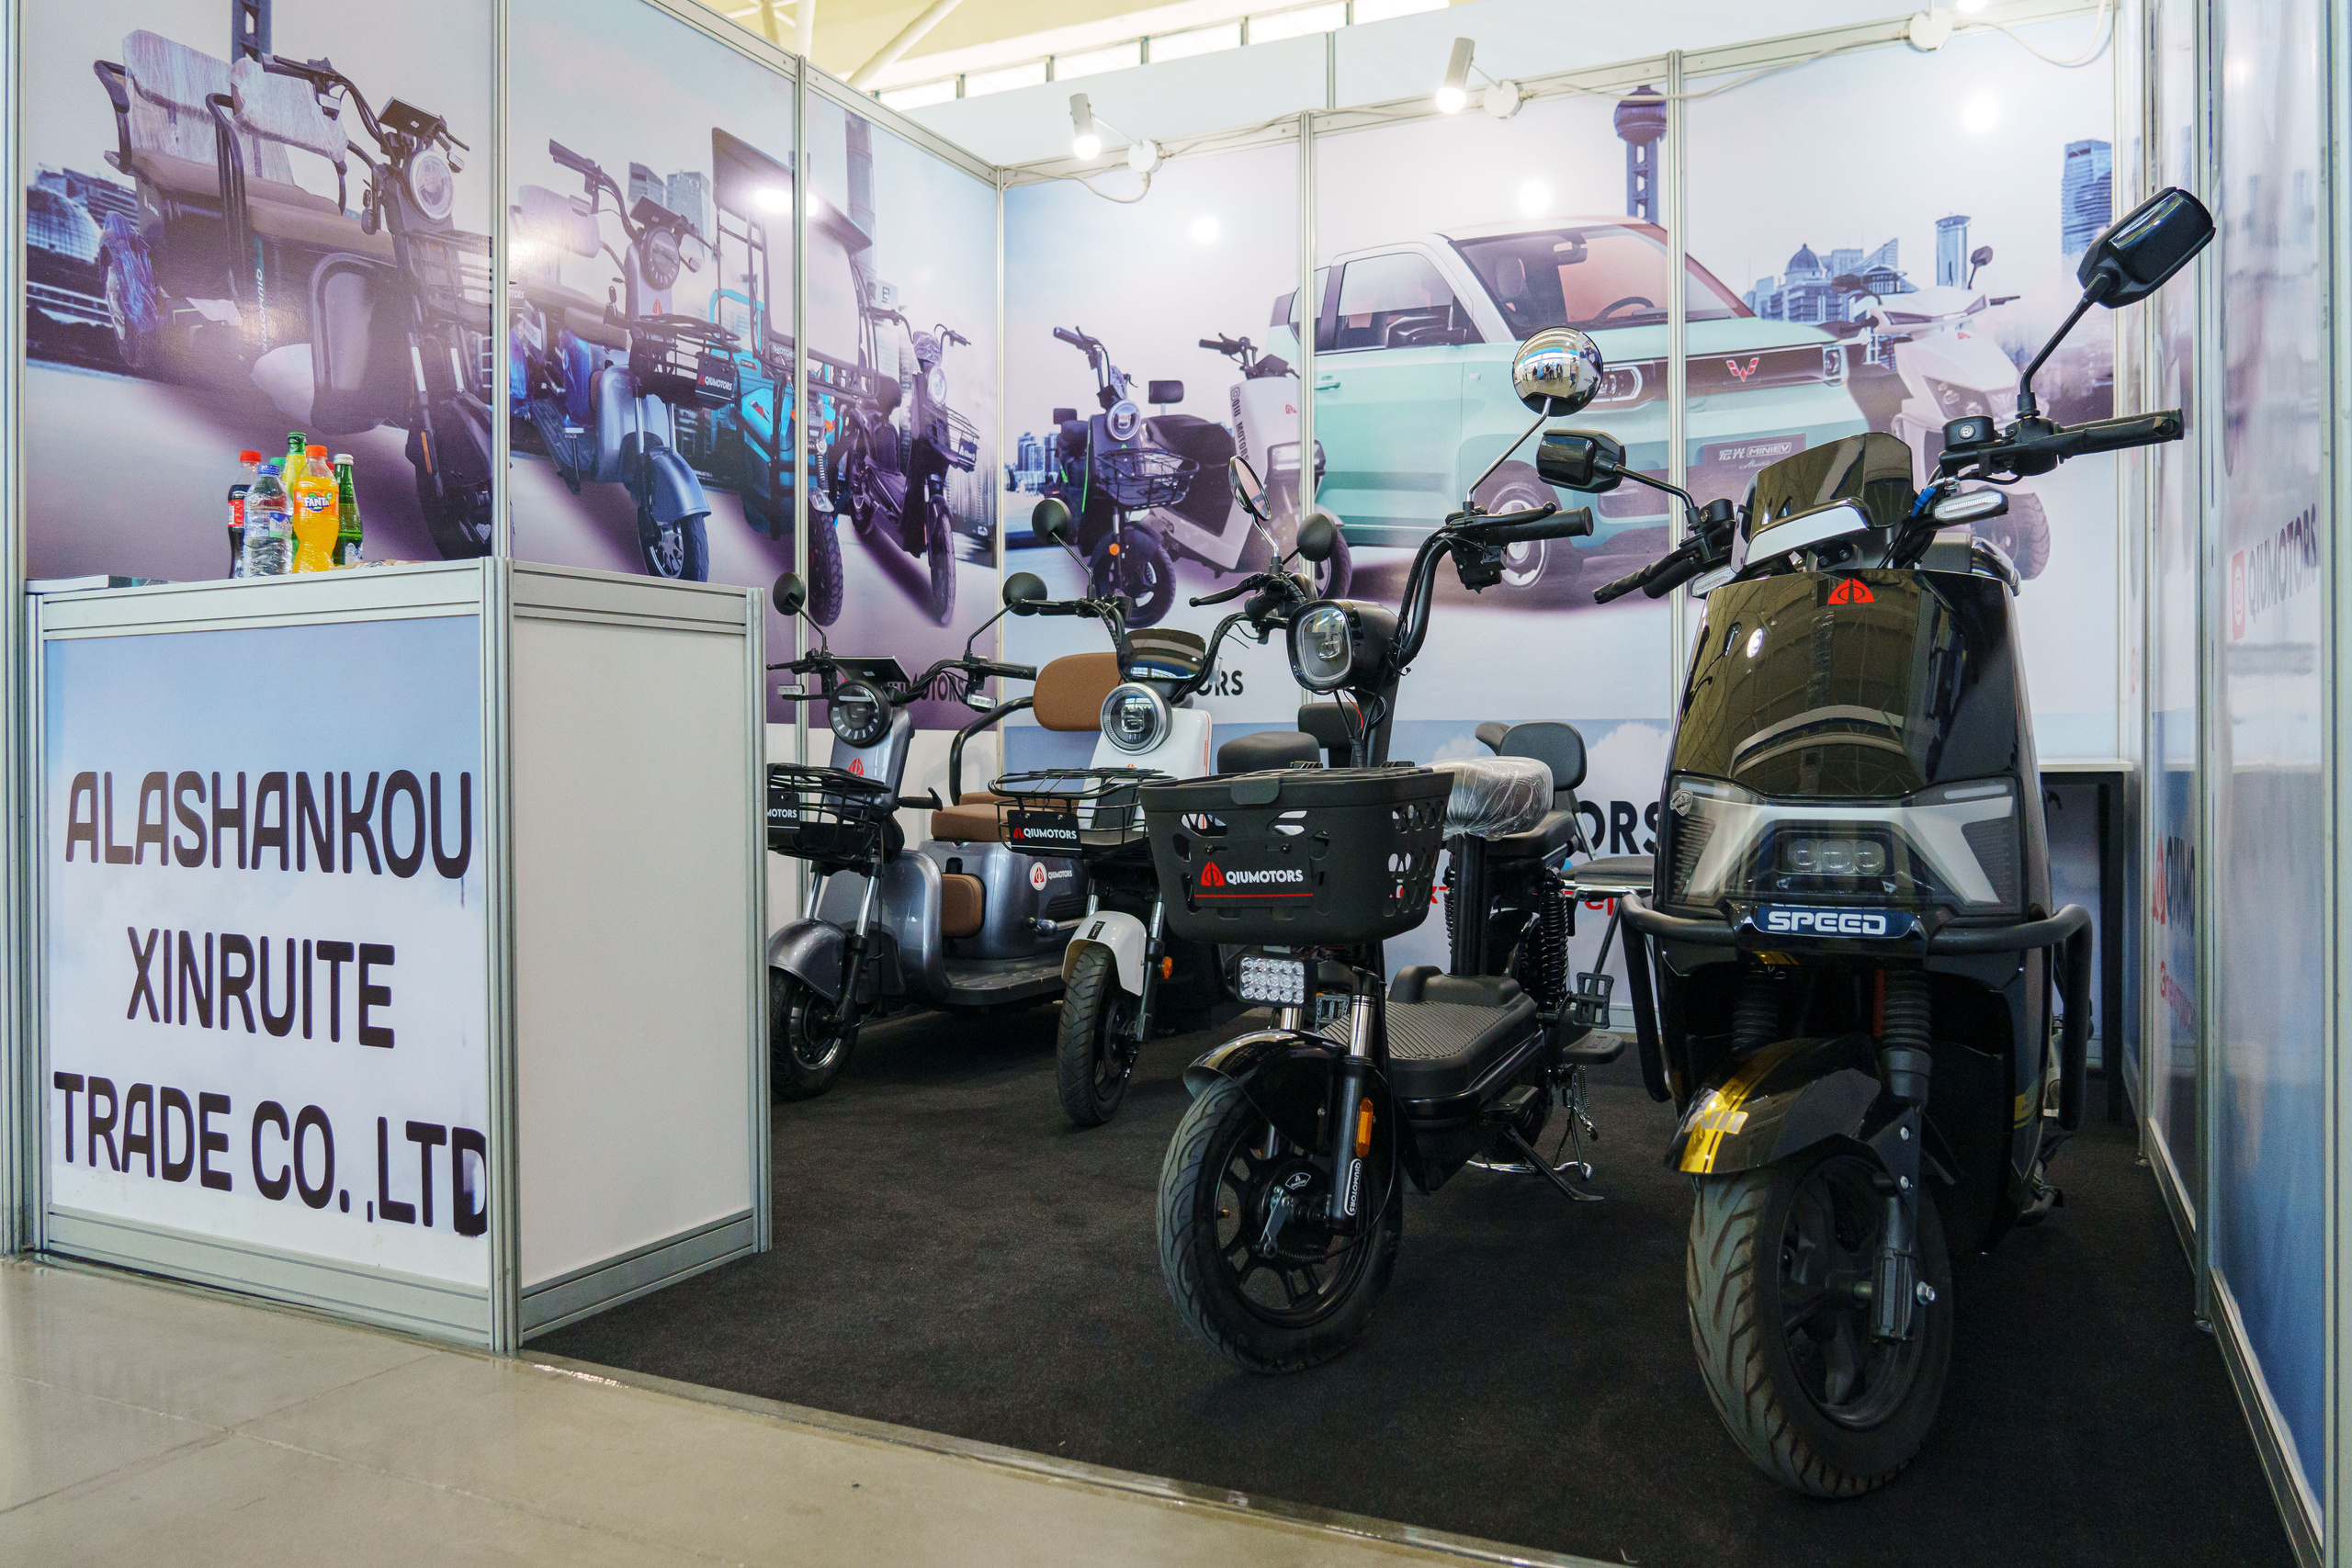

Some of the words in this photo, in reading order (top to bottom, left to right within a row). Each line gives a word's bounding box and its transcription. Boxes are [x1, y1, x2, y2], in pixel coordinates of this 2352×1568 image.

[705, 376, 733, 391] QIUMOTORS
[1748, 444, 1790, 457] MINIEV
[303, 496, 330, 507] FANTA
[2248, 503, 2316, 625] QIUMOTORS
[66, 770, 472, 879] ALASHANKOU
[1023, 828, 1077, 840] QIUMOTORS
[1047, 870, 1073, 880] QIUMOTORS
[1226, 869, 1304, 885] QIUMOTORS
[1768, 911, 1886, 935] SPEED
[127, 926, 395, 1048] XINRUITE
[53, 1071, 232, 1191] TRADE
[1349, 1162, 1362, 1213] QIUMOTORS
